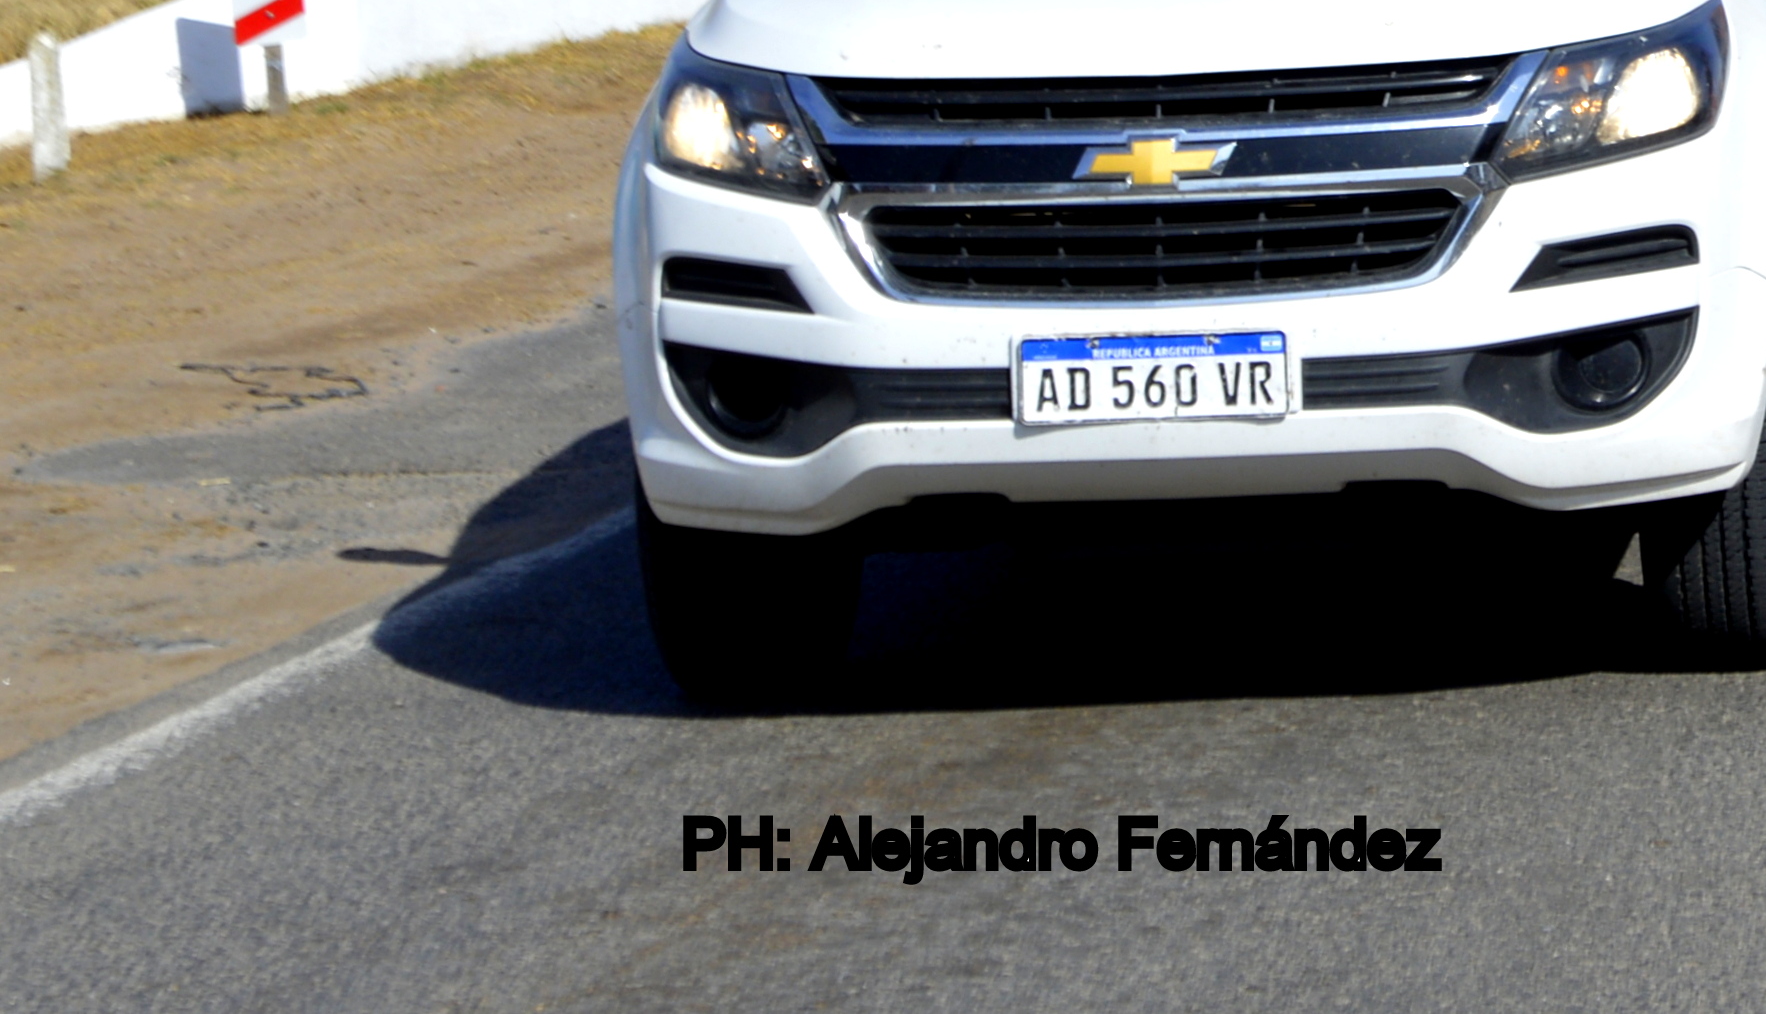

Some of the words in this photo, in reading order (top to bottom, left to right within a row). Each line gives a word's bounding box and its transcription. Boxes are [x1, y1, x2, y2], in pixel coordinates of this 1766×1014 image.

[1092, 347, 1150, 359] REPUBLICA
[1153, 345, 1215, 357] ARGENTINA
[1036, 366, 1092, 412] AD
[1111, 363, 1198, 409] 560
[1218, 361, 1274, 406] VR
